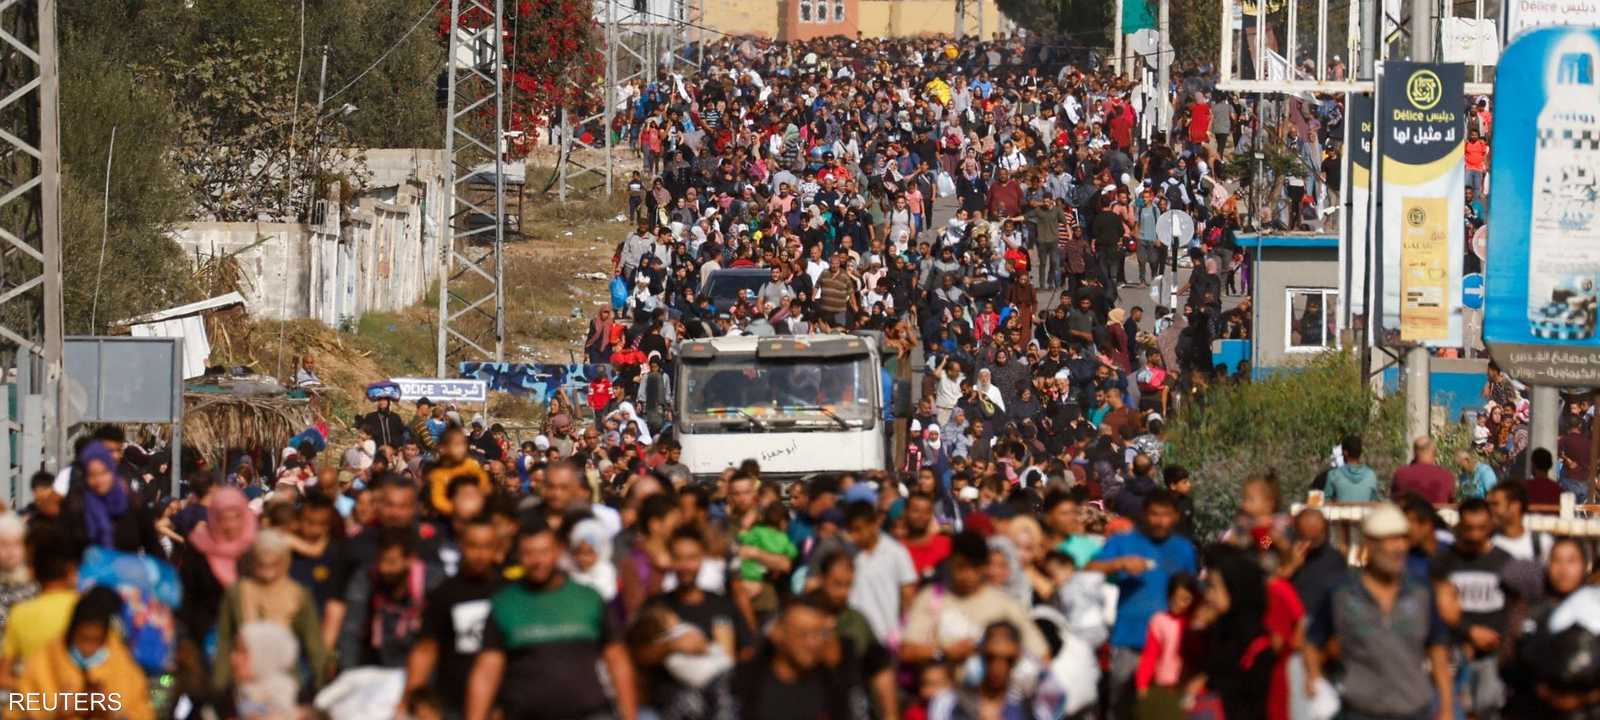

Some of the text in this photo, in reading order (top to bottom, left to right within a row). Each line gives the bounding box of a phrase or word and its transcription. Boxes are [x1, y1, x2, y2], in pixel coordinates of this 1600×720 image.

[1393, 109, 1424, 121] Délice
[1393, 124, 1455, 144] لا مثيل لها
[441, 384, 479, 397] شرطة
